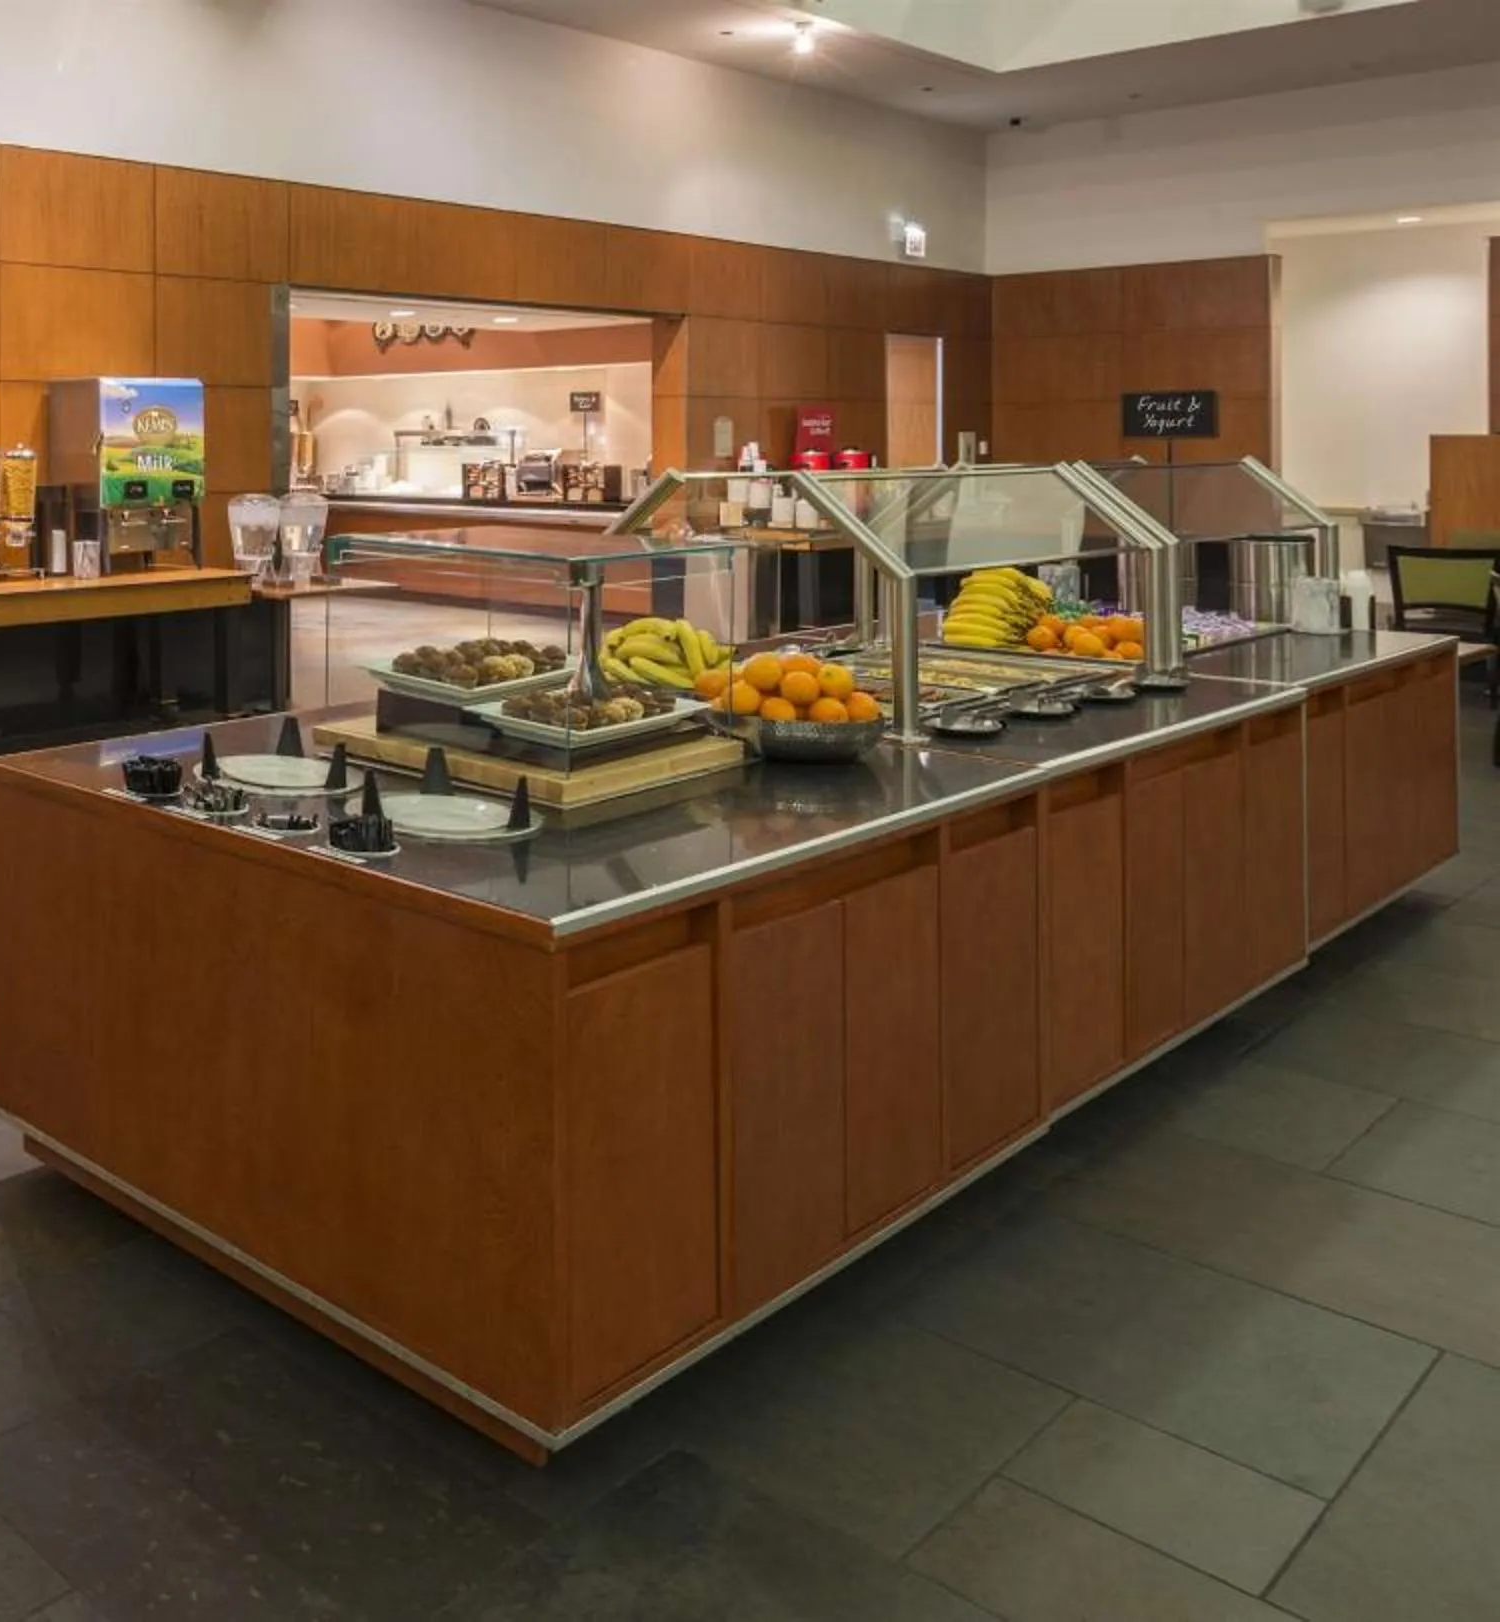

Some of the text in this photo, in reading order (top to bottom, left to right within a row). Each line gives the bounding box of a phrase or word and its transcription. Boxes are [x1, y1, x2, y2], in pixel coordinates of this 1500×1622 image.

[1137, 394, 1182, 411] Fruit
[1142, 413, 1196, 435] Yogurt
[136, 454, 175, 471] Milk
